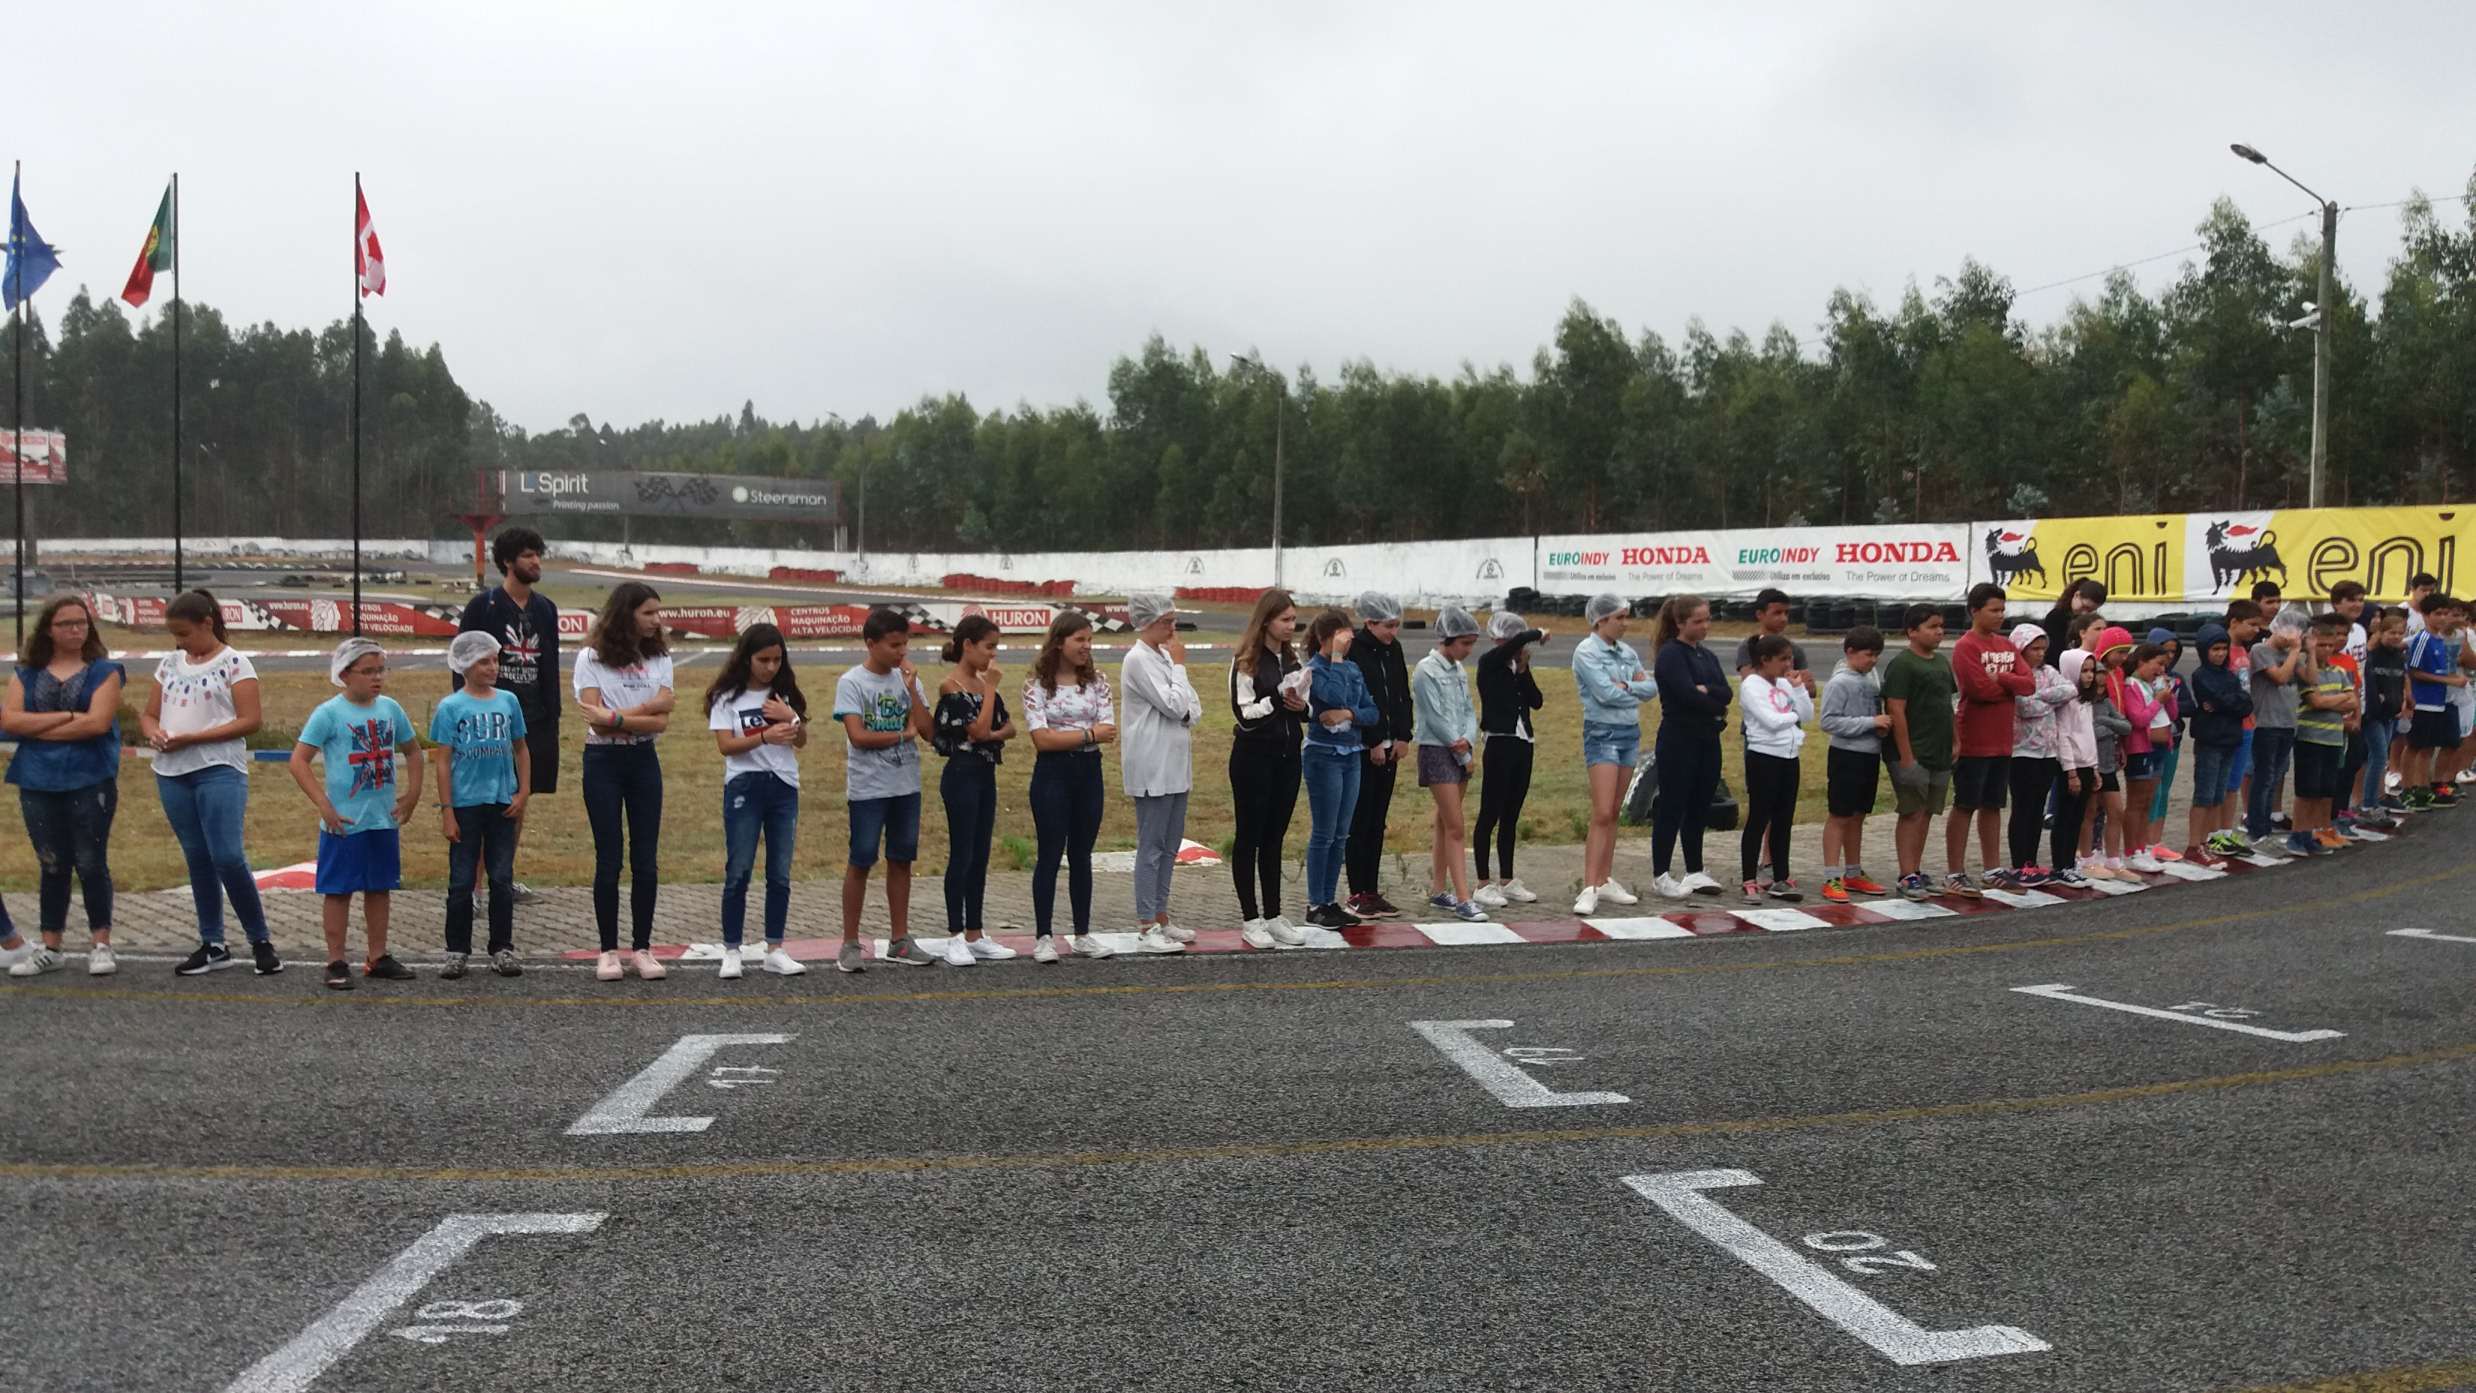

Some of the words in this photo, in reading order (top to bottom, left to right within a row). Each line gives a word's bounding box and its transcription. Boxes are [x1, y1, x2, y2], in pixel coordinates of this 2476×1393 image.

[539, 472, 589, 497] Spirit
[1548, 552, 1610, 566] EUROINDY
[1620, 546, 1711, 566] HONDA
[1737, 547, 1821, 565] EUROINDY
[1835, 541, 1961, 564] HONDA
[2061, 520, 2168, 596] eni
[2306, 512, 2456, 596] eni
[1846, 570, 1864, 581] The
[1866, 571, 1897, 582] Power
[1899, 571, 1908, 581] of
[1910, 571, 1951, 582] Dreams
[658, 608, 730, 618] ww.huron.eu
[790, 607, 831, 616] CENTROS
[790, 614, 850, 625] MAQUINAÇÃO
[992, 609, 1046, 625] HURON
[791, 626, 813, 634] ALTA
[815, 625, 865, 634] VELOCIDAD
[452, 711, 512, 745] SUR
[1803, 1231, 1937, 1274] 20
